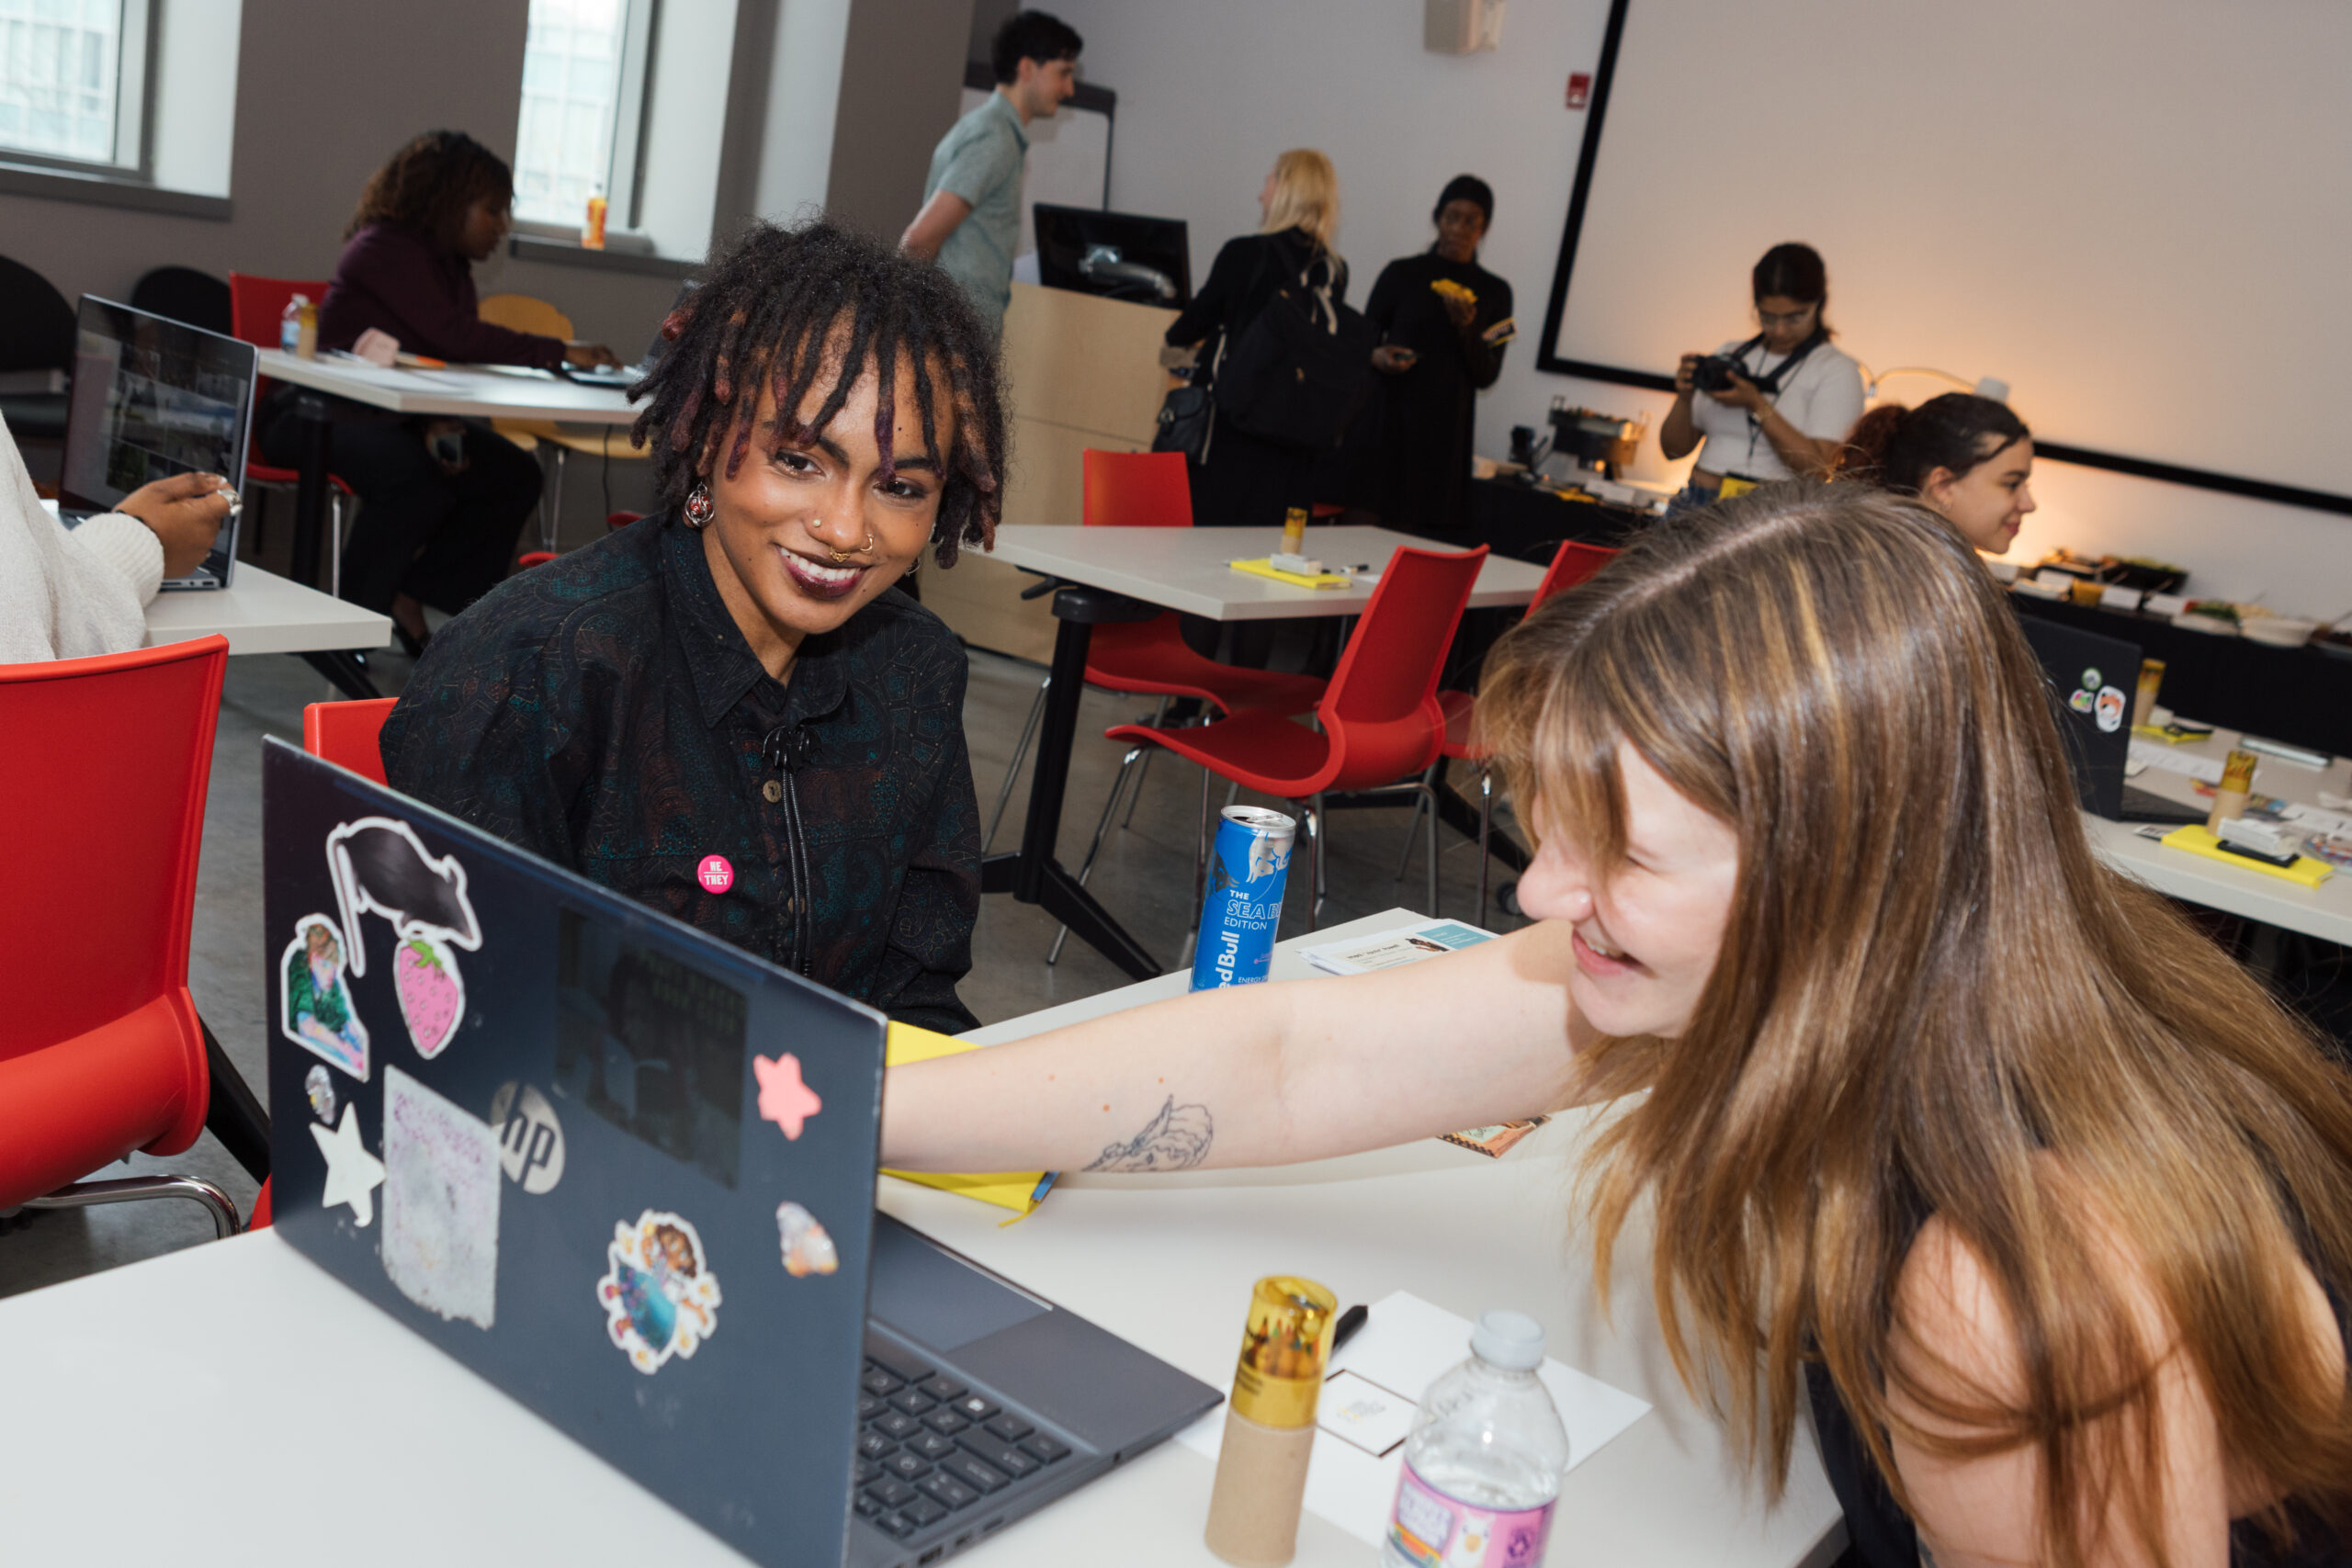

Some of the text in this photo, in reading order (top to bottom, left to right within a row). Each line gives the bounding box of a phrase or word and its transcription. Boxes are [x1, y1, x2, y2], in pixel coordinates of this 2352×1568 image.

[709, 861, 722, 872] HE
[704, 874, 729, 885] THEY
[1230, 889, 1250, 900] THE
[1227, 899, 1265, 919] SEA
[1224, 917, 1267, 931] EDITION
[1217, 931, 1240, 968] Bull
[499, 1080, 558, 1194] hp
